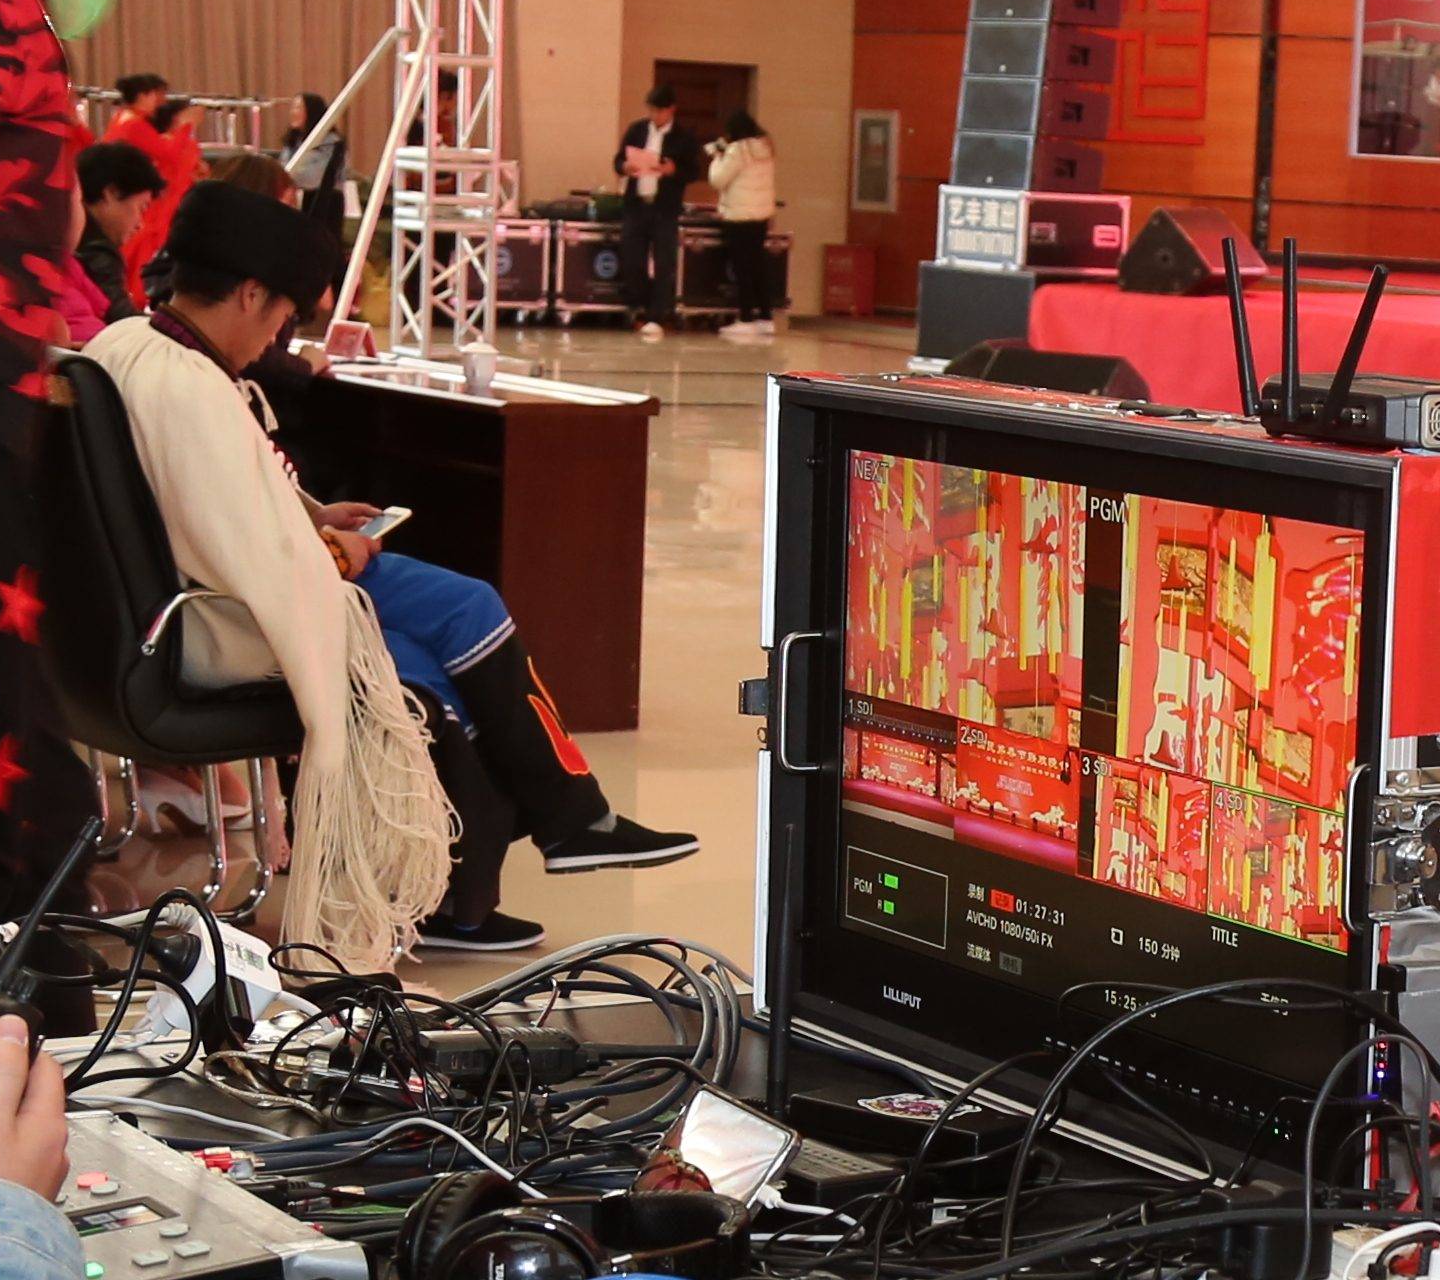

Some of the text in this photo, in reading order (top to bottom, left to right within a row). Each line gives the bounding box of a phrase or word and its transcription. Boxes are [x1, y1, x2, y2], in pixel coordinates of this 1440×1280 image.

[853, 458, 889, 484] NEXT
[1090, 495, 1126, 524] PGM
[856, 700, 874, 716] SDI
[1081, 756, 1090, 776] 3
[853, 876, 873, 895] PGM
[1015, 898, 1066, 927] 01:27:31
[966, 909, 1054, 948] AVCHD 1080/50i FX
[1210, 925, 1240, 948] TITLE
[1138, 936, 1181, 963] 150 分钟
[882, 984, 922, 1010] LILLIPUT
[1105, 989, 1157, 1019] 15:25:
